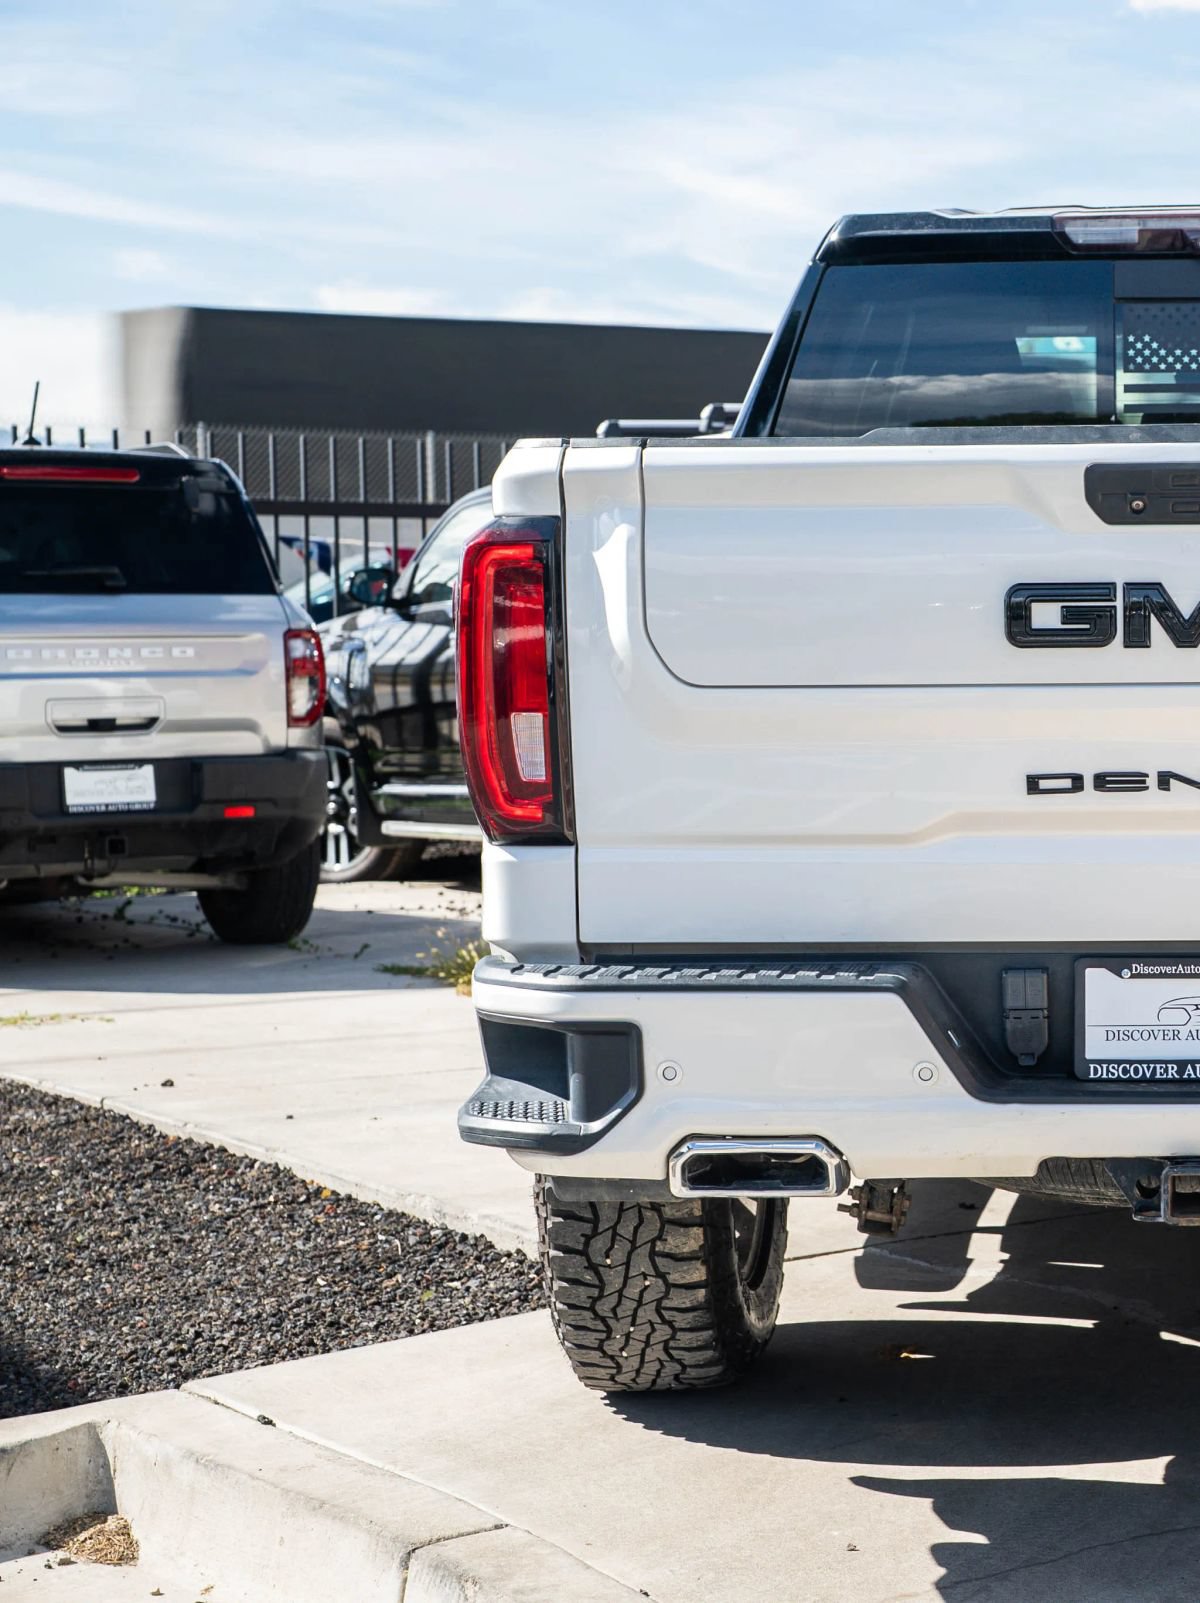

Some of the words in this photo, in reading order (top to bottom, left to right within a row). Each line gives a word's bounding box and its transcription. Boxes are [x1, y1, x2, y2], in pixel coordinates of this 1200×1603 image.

[6, 647, 195, 659] BRONCO
[1104, 1029, 1182, 1042] DISCOVER
[1088, 1063, 1180, 1079] DISCOVER
